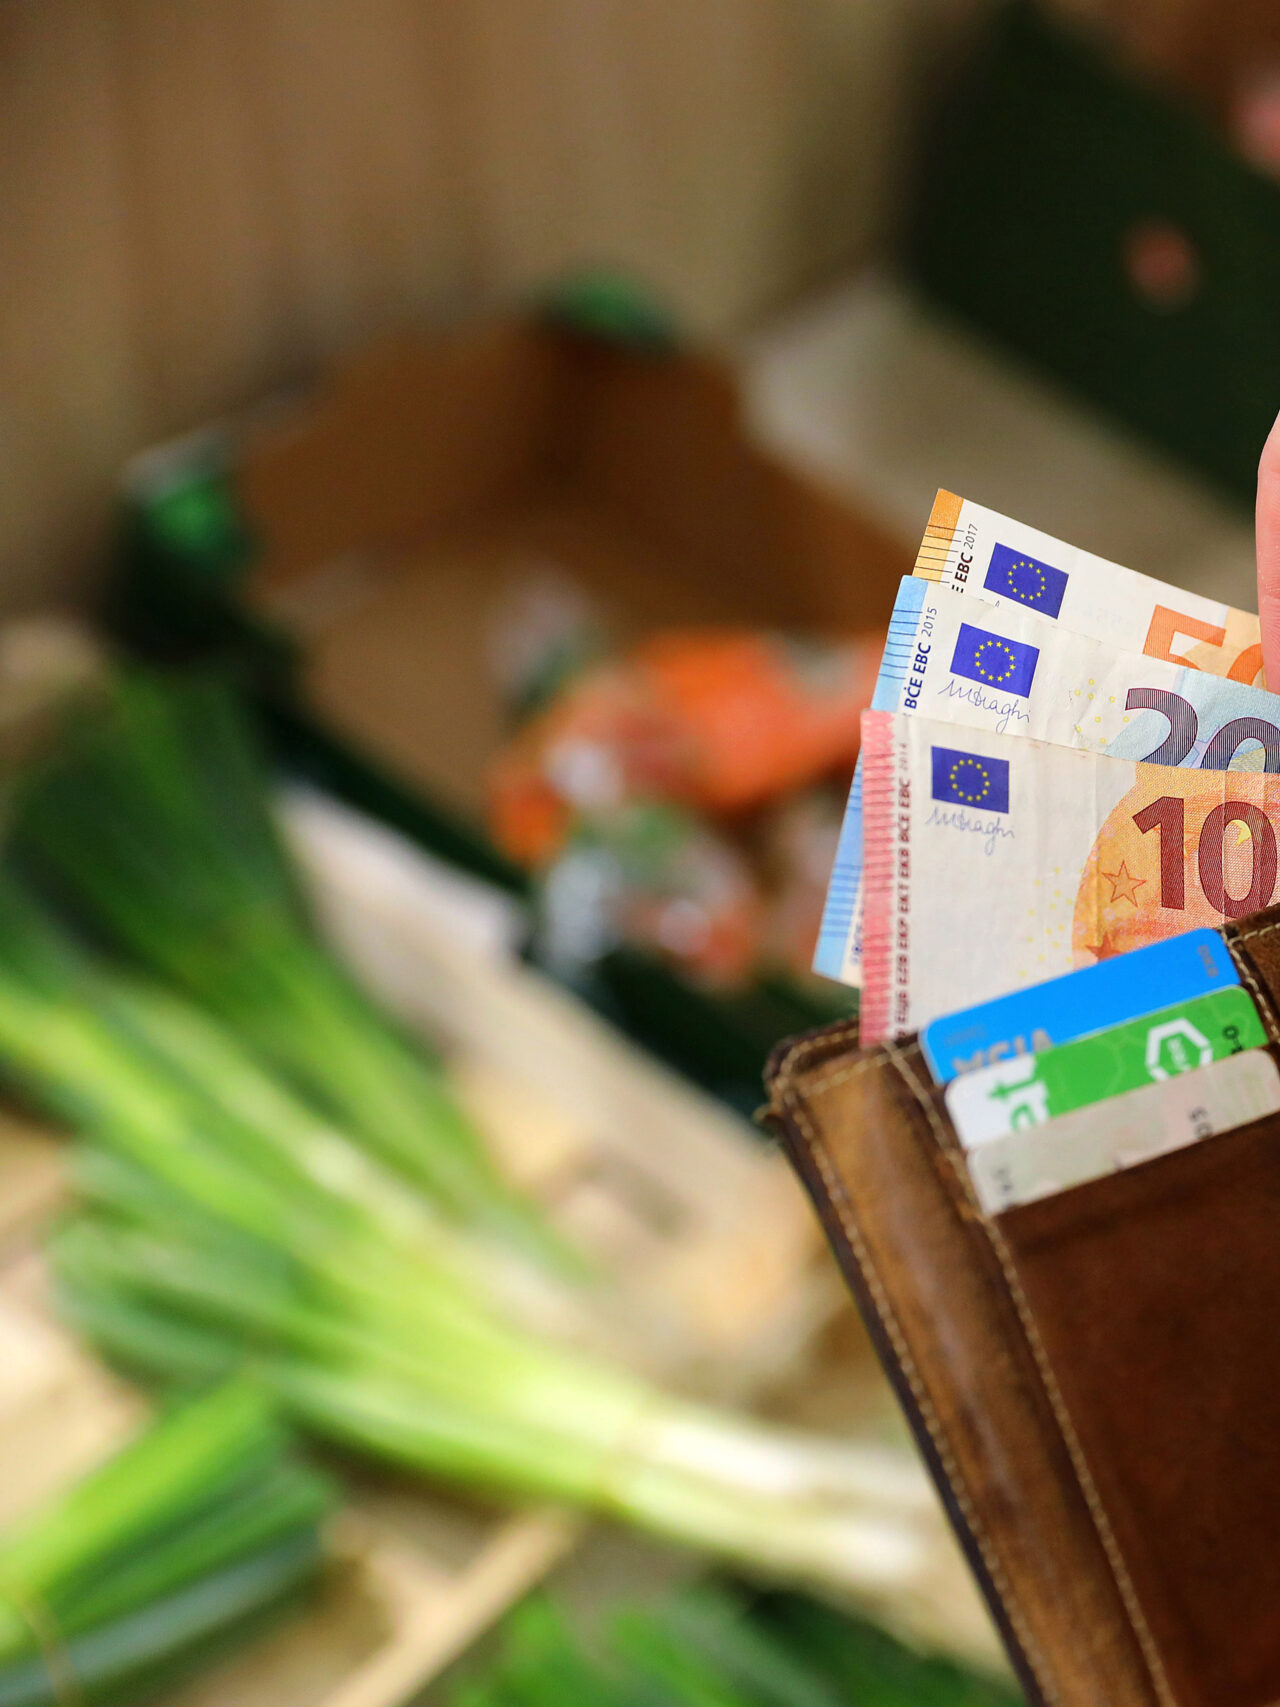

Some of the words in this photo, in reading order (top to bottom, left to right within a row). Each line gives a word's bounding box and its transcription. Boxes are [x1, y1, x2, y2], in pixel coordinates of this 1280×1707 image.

[963, 523, 979, 549] 2017
[954, 552, 973, 583] EBC
[920, 606, 938, 637] 2015
[912, 642, 931, 674] EBC
[1132, 795, 1278, 919] 10
